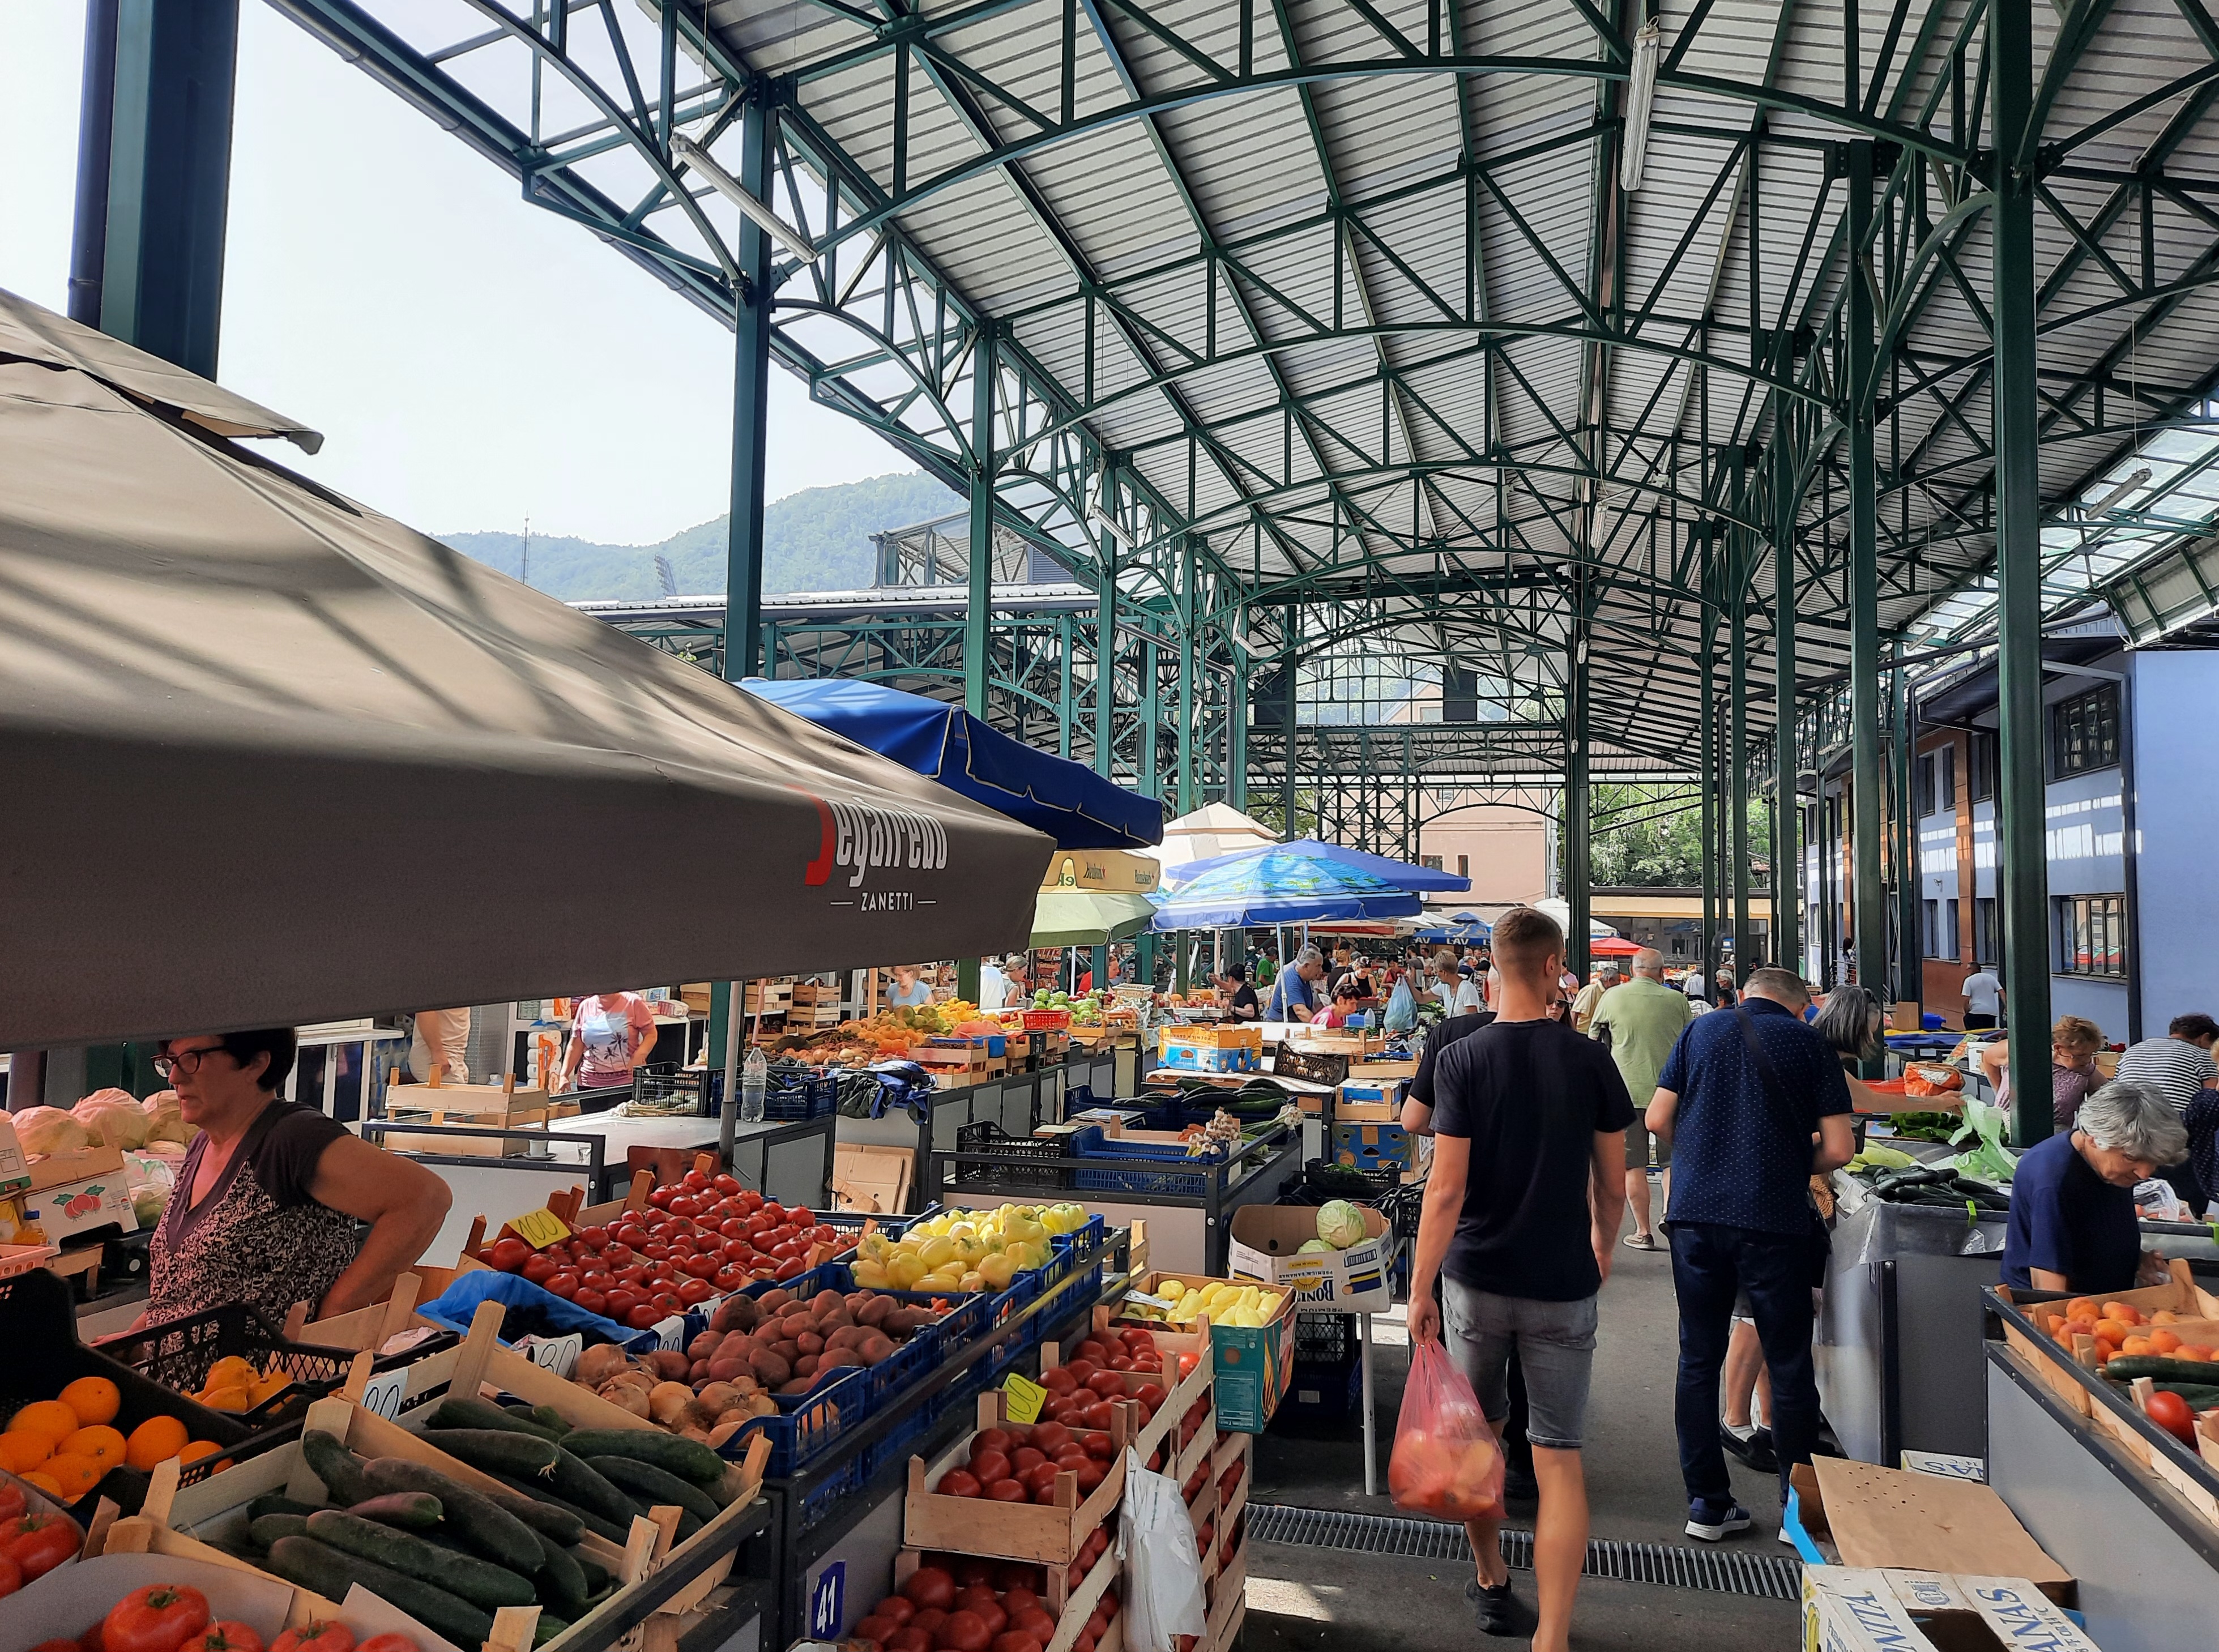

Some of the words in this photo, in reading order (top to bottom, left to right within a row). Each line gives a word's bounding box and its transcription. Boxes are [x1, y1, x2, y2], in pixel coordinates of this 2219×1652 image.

[861, 892, 913, 911] ZANETTI
[518, 1211, 558, 1243] 100
[817, 1575, 837, 1634] 41
[1841, 1594, 1918, 1652] NITA
